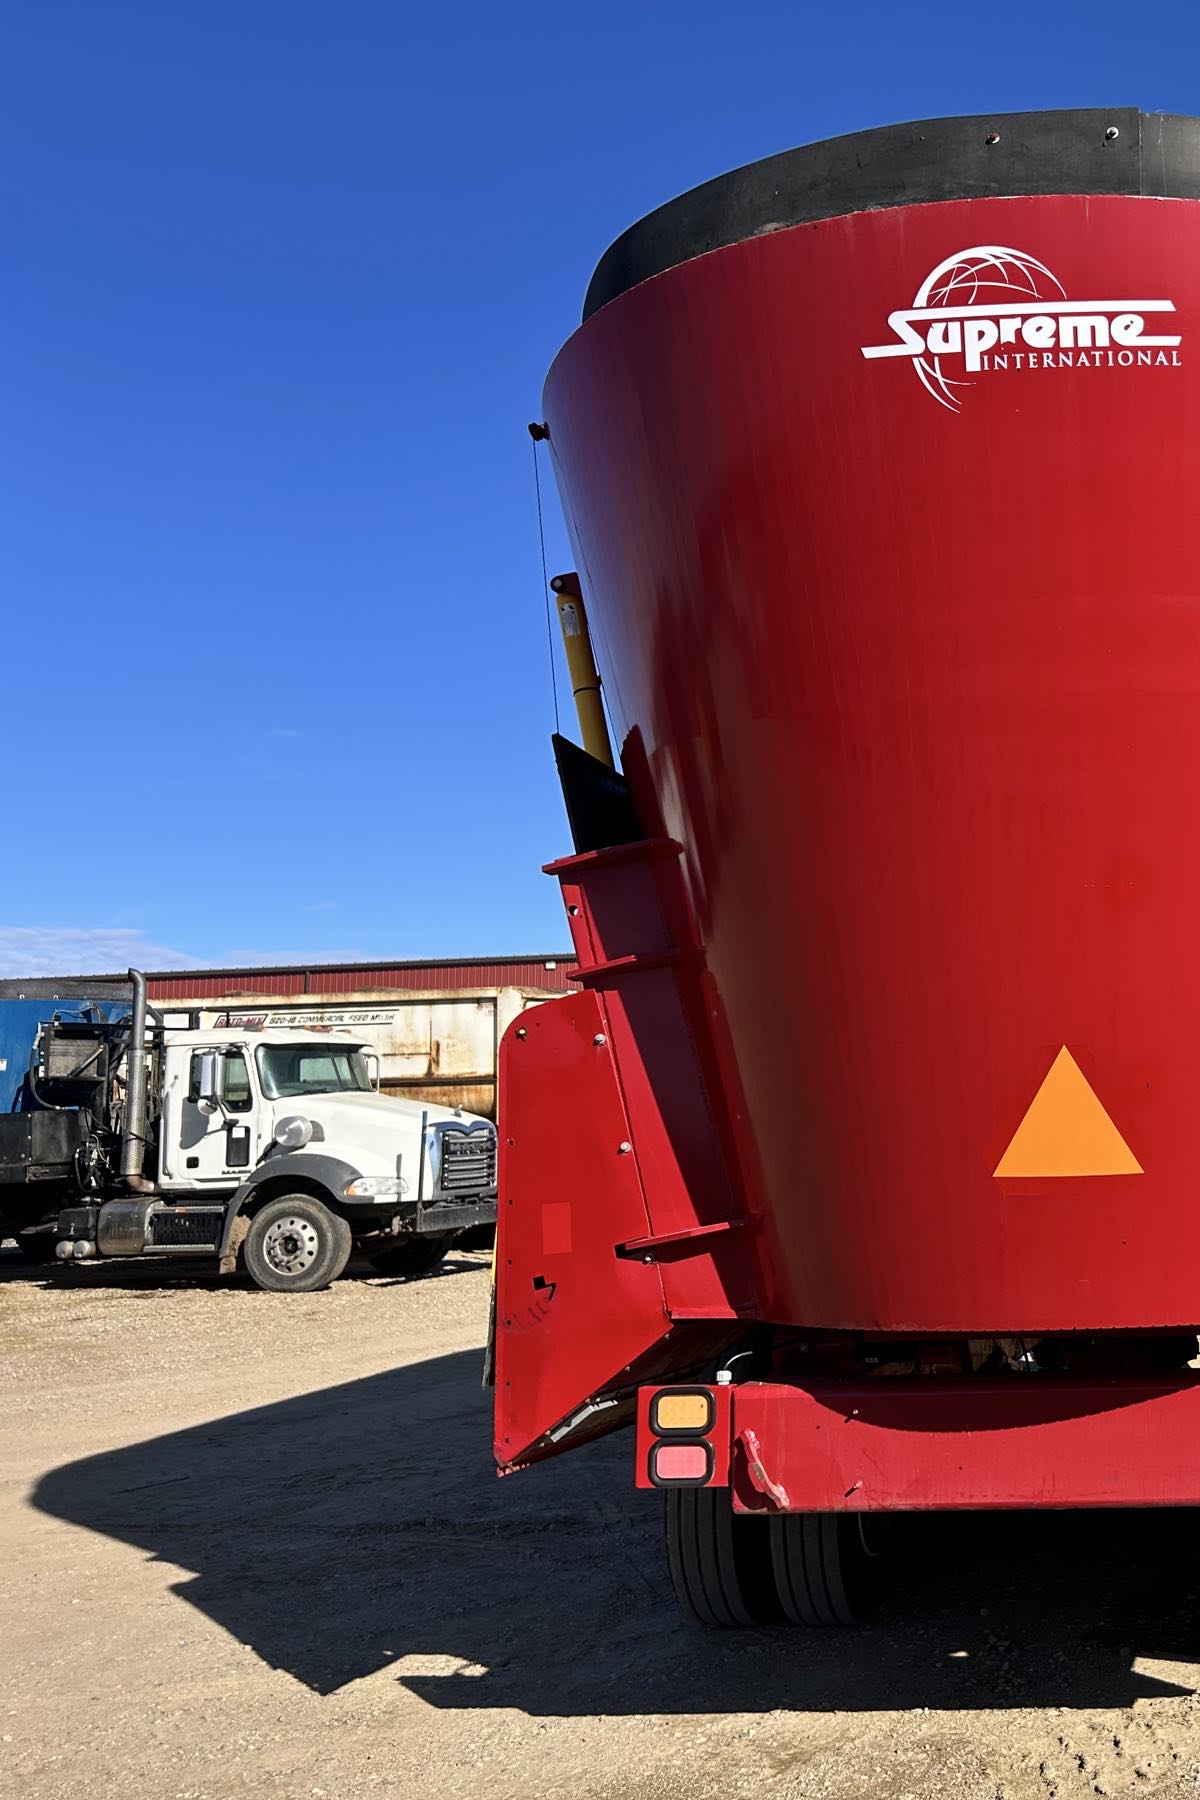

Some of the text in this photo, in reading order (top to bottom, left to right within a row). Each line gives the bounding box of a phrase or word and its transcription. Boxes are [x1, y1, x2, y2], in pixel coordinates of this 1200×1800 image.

[861, 299, 1182, 372] Supreme
[983, 350, 1182, 370] INTERNATIONAL
[218, 1017, 263, 1027] RTO-MIX
